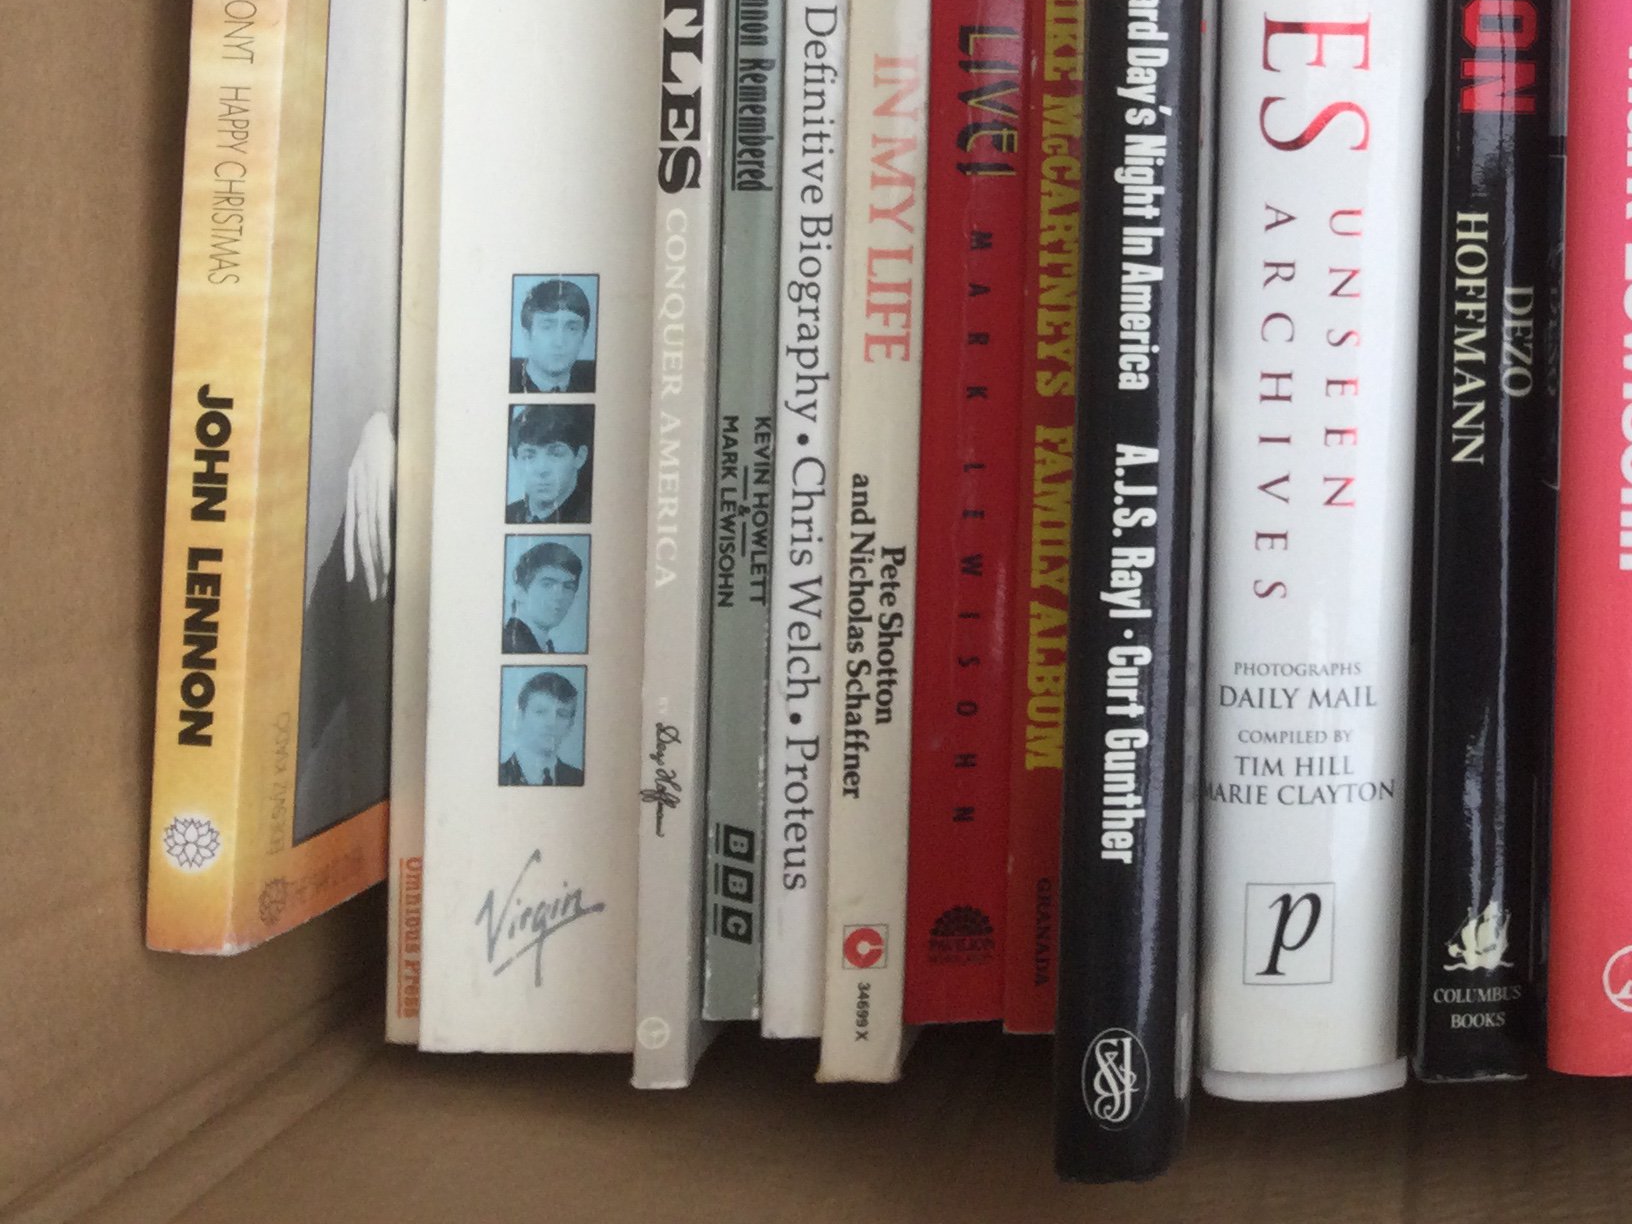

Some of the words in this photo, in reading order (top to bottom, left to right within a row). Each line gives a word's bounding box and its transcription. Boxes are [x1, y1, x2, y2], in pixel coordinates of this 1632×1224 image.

[215, 86, 250, 153] HAPPY
[736, 58, 776, 192] Remembered
[801, 6, 839, 204] Definitive
[872, 53, 920, 122] IN
[207, 162, 247, 285] CHRISTMAS
[869, 134, 917, 234] MY
[1114, 135, 1167, 218] Night
[1121, 227, 1164, 254] In
[660, 208, 688, 395] CONQUER
[785, 214, 833, 423] Biography
[864, 246, 914, 363] LIFE
[966, 230, 993, 400] MARK
[1118, 263, 1163, 390] America
[1322, 208, 1363, 507] UNSEEN
[1451, 211, 1488, 464] HOFFMANN
[1500, 286, 1535, 397] DEZO
[189, 384, 234, 522] JOHN
[653, 411, 682, 588] AMERICA
[720, 416, 740, 480] MARK
[752, 416, 772, 484] KEVIN
[849, 474, 875, 525] and
[716, 487, 738, 607] LEWISOHN
[737, 504, 751, 516] &
[749, 492, 770, 605] HOWLETT
[789, 456, 826, 566] Chris
[846, 532, 874, 653] Nicholas
[878, 546, 906, 606] Pete
[1101, 548, 1153, 618] Rayl
[178, 547, 224, 746] LENNON
[785, 579, 823, 700] Welch
[874, 613, 904, 724] Shotton
[952, 463, 984, 823] LEWISOHN
[1025, 601, 1070, 770] ALBUM
[1106, 646, 1151, 718] Curt
[1234, 662, 1362, 676] PHOTOGRAPHS
[841, 659, 872, 799] Schaffner
[1219, 685, 1300, 710] DAILY
[1309, 687, 1377, 708] MAIL
[1238, 730, 1327, 744] COMPILED
[1333, 729, 1353, 743] BY
[783, 736, 820, 890] Proteus
[1101, 729, 1149, 863] Gunther
[1235, 756, 1284, 776] TIM
[1296, 756, 1354, 776] HILL
[1277, 779, 1395, 805] CLAYTON
[723, 828, 752, 942] BBC
[1034, 878, 1051, 987] GRANADA
[1433, 986, 1521, 1003] COLUMBUS
[1451, 1012, 1506, 1028] BOOKS
